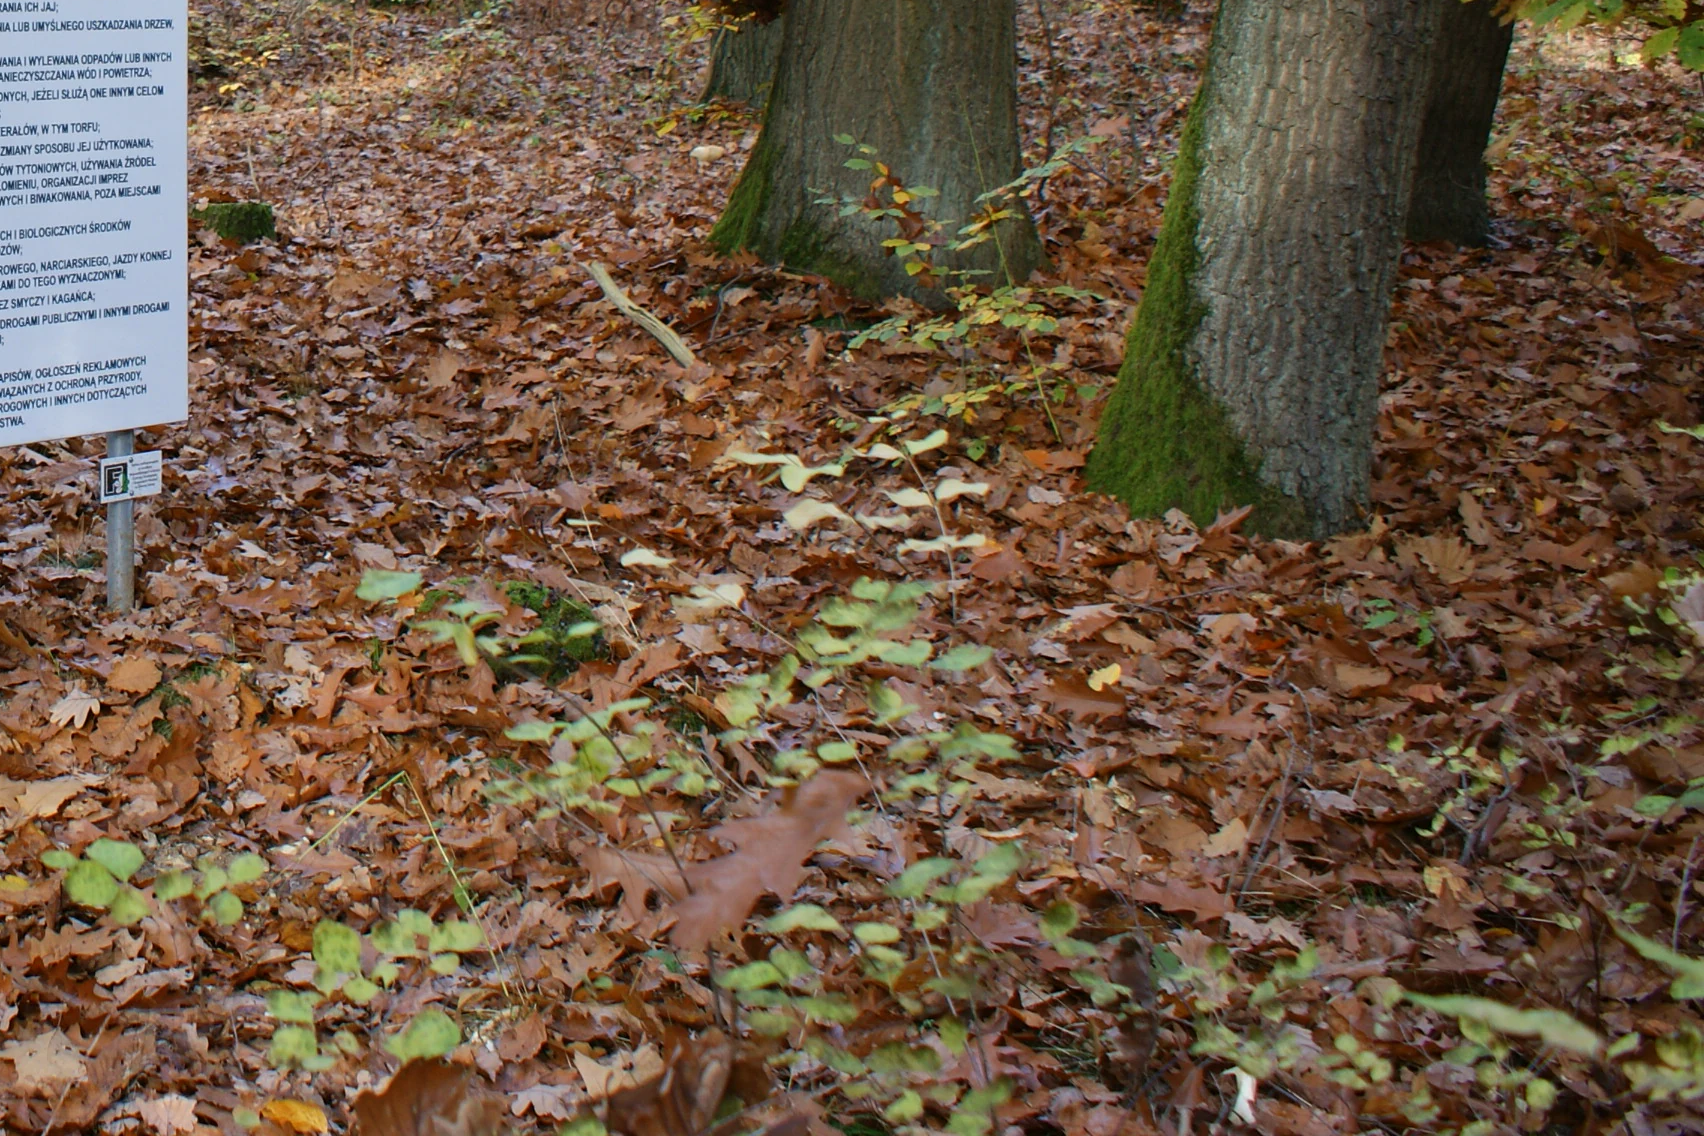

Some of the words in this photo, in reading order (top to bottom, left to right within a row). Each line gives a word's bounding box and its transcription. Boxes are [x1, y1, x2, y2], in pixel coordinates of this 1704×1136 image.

[23, 1, 39, 12] ICH
[40, 1, 58, 13] JAJ;
[11, 21, 30, 32] LUB
[31, 19, 84, 32] UMYŚLNEGO
[85, 19, 143, 30] USZKADZANIA
[143, 19, 174, 29] DRZEW,
[27, 54, 80, 66] WYLEWANIA
[80, 51, 123, 65] ODPADÓW
[124, 52, 141, 63] LUB
[141, 52, 172, 62] INNYCH
[76, 66, 97, 79] WÓD
[102, 67, 152, 78] POWIETRZA;
[30, 87, 59, 100] JEŻELI
[60, 86, 88, 101] SŁUŻĄ
[89, 87, 107, 98] ONE
[108, 86, 134, 97] INNYM
[135, 85, 164, 96] CELOM
[50, 123, 69, 134] TYM
[69, 121, 100, 133] TORFU;
[0, 144, 32, 156] ZMIANY
[33, 142, 75, 154] SPOSOBU
[76, 141, 91, 152] JEJ
[92, 138, 153, 151] UŻYTKOWANIA;
[14, 161, 79, 175] TYTONIOWYCH,
[80, 158, 123, 171] UŻYWANIA
[123, 155, 156, 168] ŹRÓDEŁ
[40, 175, 97, 188] ORGANIZACJI
[98, 172, 128, 184] IMPREZ
[29, 190, 92, 204] BIWAKOWANIA,
[94, 188, 117, 199] POZA
[117, 184, 161, 197] MIEJSCAMI
[18, 224, 87, 239] BIOLOGICZNYCH
[88, 218, 131, 233] ŚRODKÓW
[39, 255, 111, 271] NARCIARSKIEGO,
[112, 253, 138, 265] JAZDY
[139, 249, 172, 262] KONNEJ
[17, 277, 31, 289] DO
[32, 275, 56, 287] TEGO
[57, 269, 126, 284] WYZNACZONYMI;
[10, 295, 45, 309] SMYCZY
[51, 289, 95, 304] KAGAŃCA;
[0, 315, 40, 329] DROGAMI
[41, 309, 97, 324] PUBLICZNYMI
[103, 305, 131, 318] INNYMI
[132, 301, 170, 315] DROGAMI
[34, 361, 81, 379] OGŁOSZEŃ
[82, 355, 146, 372] REKLAMOWYCH
[54, 376, 97, 395] OCHRONĄ
[97, 370, 142, 391] PRZYRODY,
[53, 392, 85, 406] INNYCH
[86, 383, 147, 401] DOTYCZĄCYCH
